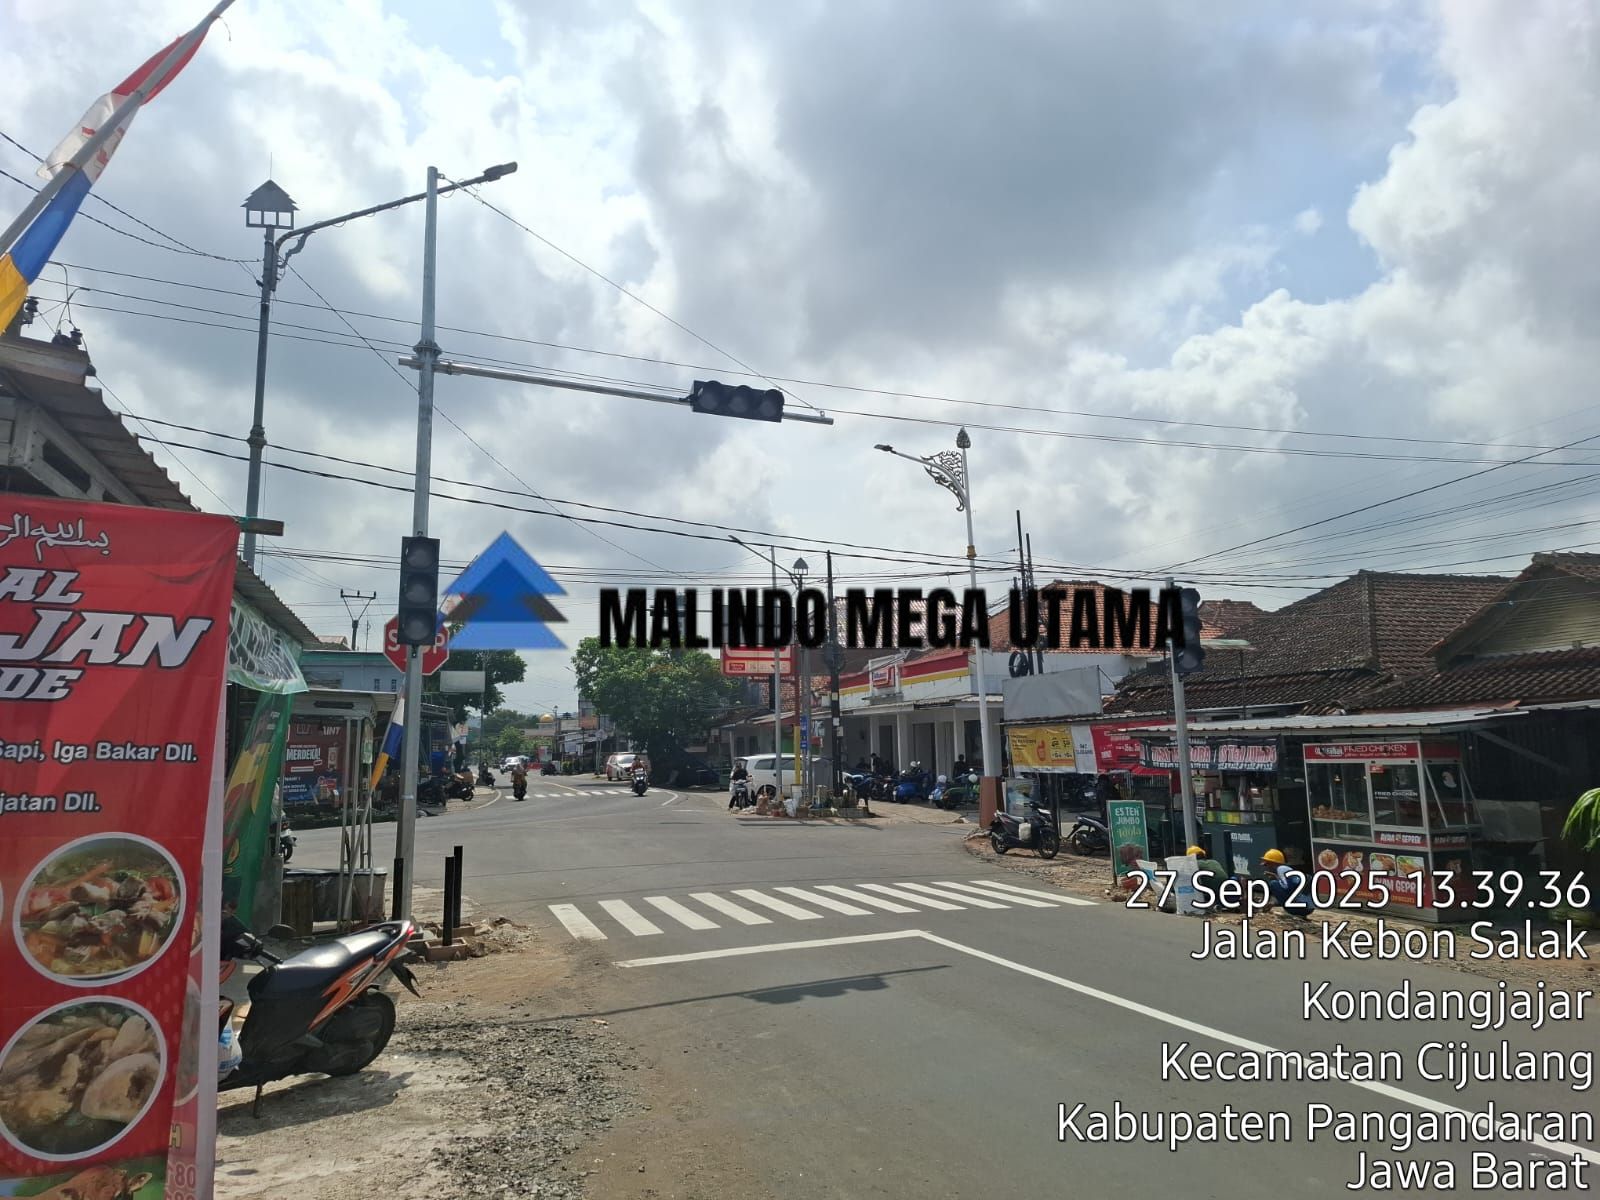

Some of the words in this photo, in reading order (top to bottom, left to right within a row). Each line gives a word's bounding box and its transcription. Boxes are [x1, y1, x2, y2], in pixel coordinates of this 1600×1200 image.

[0, 567, 82, 603] AL
[388, 629, 445, 654] SP
[54, 741, 88, 762] Iga
[96, 742, 159, 761] Bakar
[165, 743, 198, 761] Dll.
[64, 793, 101, 811] Dll.
[1117, 816, 1140, 826] JUMBO
